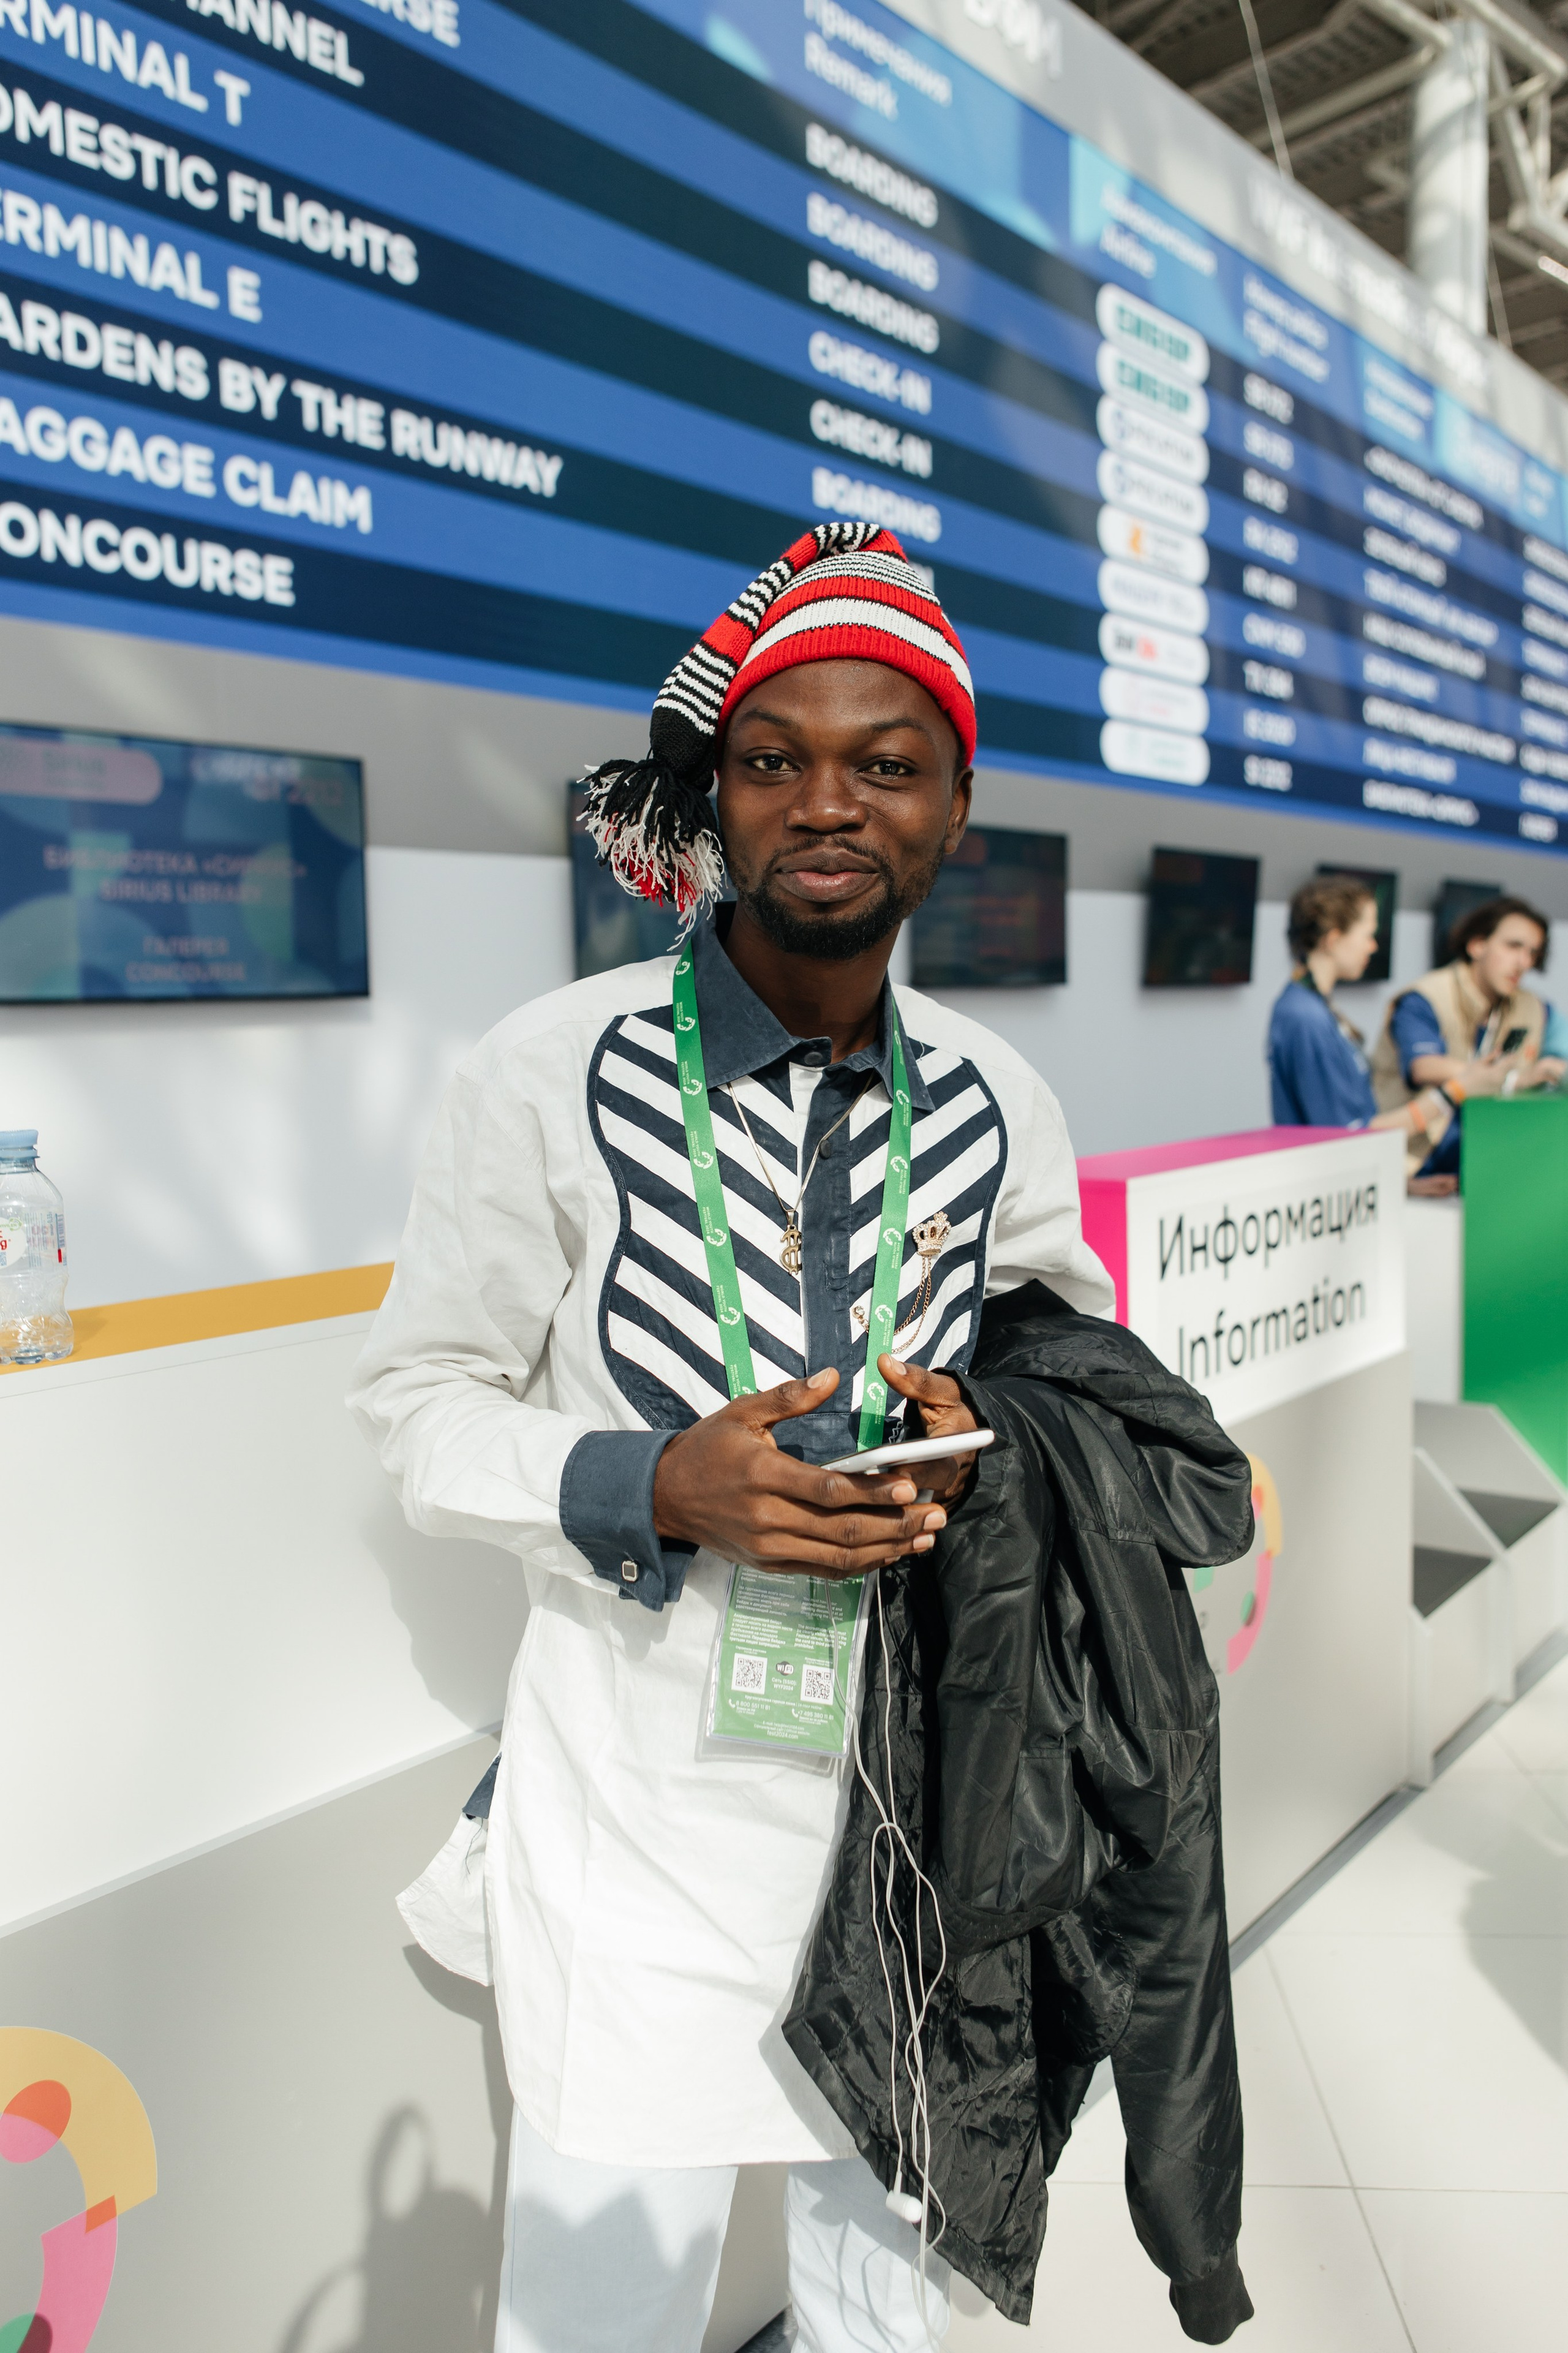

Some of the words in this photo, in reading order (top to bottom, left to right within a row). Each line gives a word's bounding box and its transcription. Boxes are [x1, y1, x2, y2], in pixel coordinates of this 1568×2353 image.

[214, 69, 251, 126] T
[227, 169, 419, 285] FLIGHTS
[227, 265, 263, 323] E
[809, 330, 932, 415] CHECK-IN
[219, 357, 286, 420] BY
[291, 379, 387, 450] THE
[391, 409, 564, 497] RUNWAY
[809, 399, 933, 479] CHECK-IN
[222, 455, 373, 535] CLAIM
[1158, 1184, 1379, 1282] Информация
[1178, 1277, 1366, 1383] Information
[767, 1730, 798, 1739] fest2024.com
